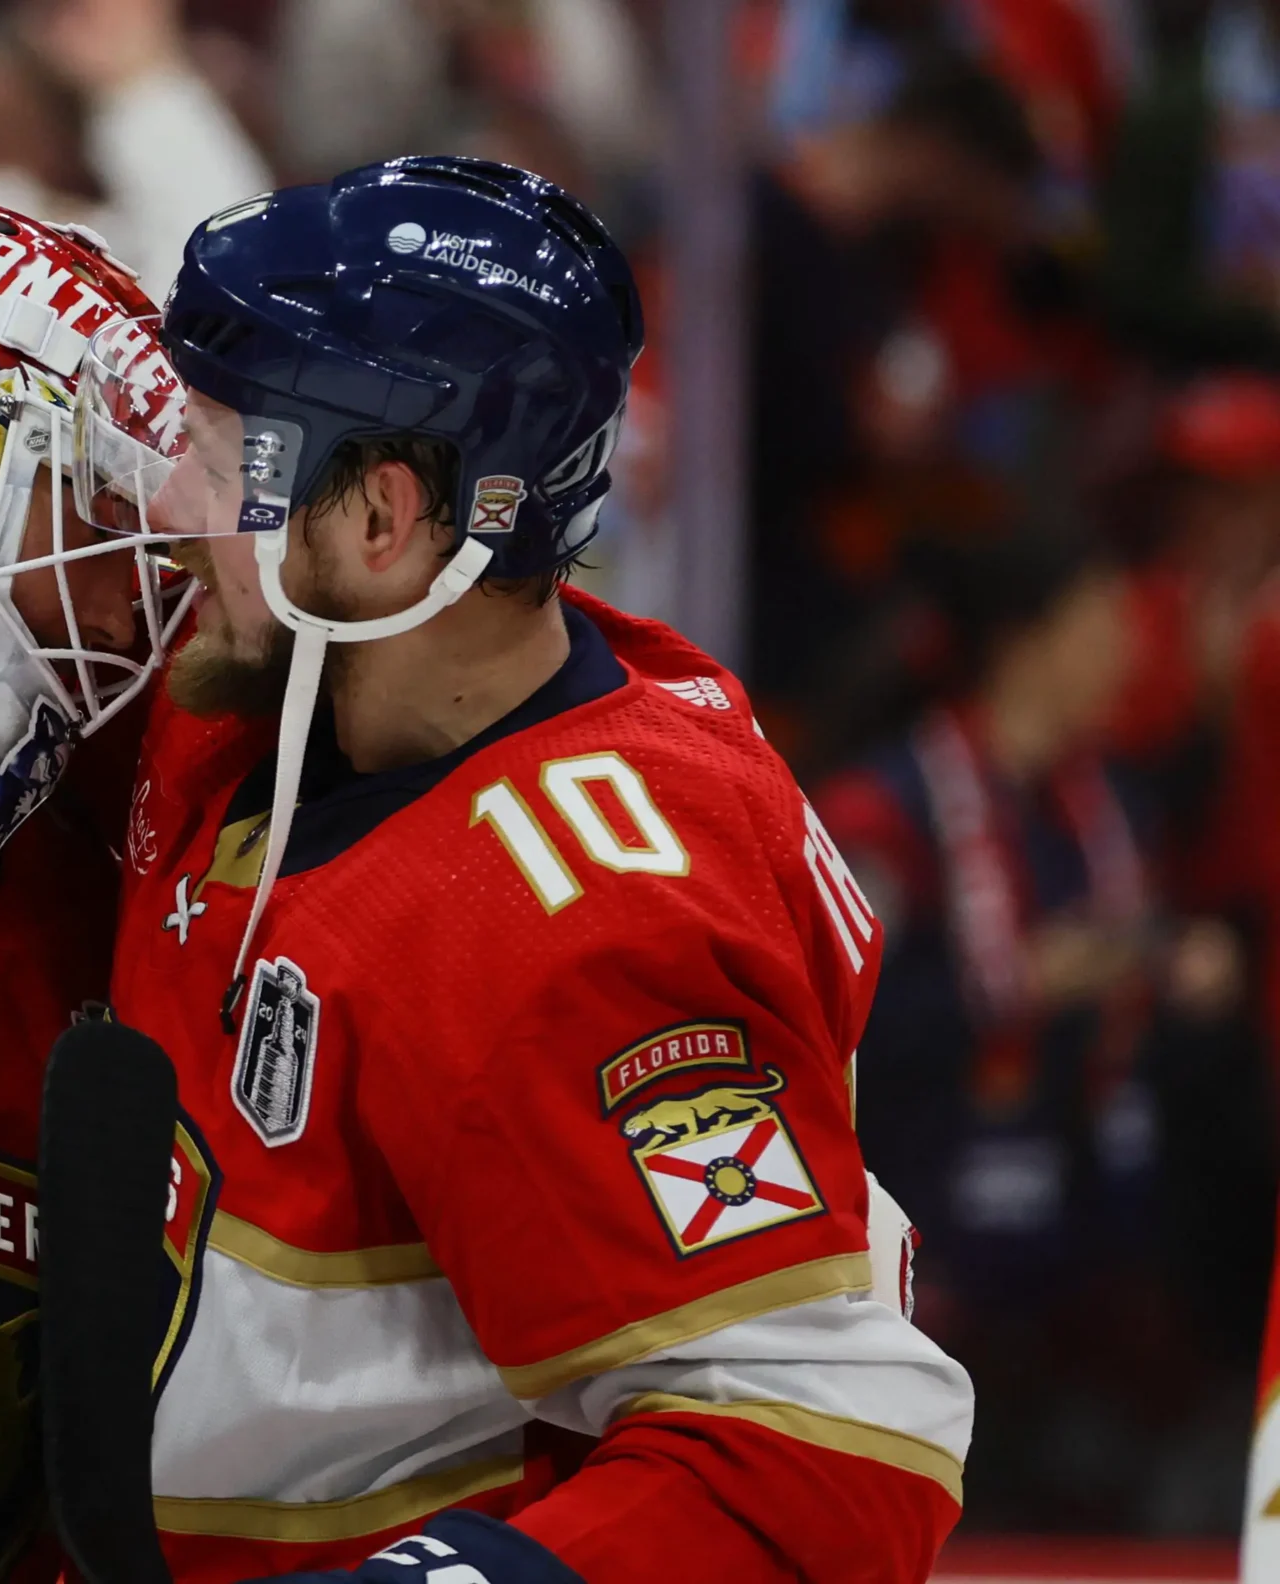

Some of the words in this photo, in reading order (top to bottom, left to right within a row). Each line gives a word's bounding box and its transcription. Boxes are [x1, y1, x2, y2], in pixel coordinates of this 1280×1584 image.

[431, 230, 478, 254] VISIT
[423, 244, 554, 301] LAUDERDALE
[469, 751, 690, 916] 10
[258, 1002, 273, 1022] 20
[294, 1025, 308, 1045] 24
[619, 1033, 729, 1088] FLORIDA
